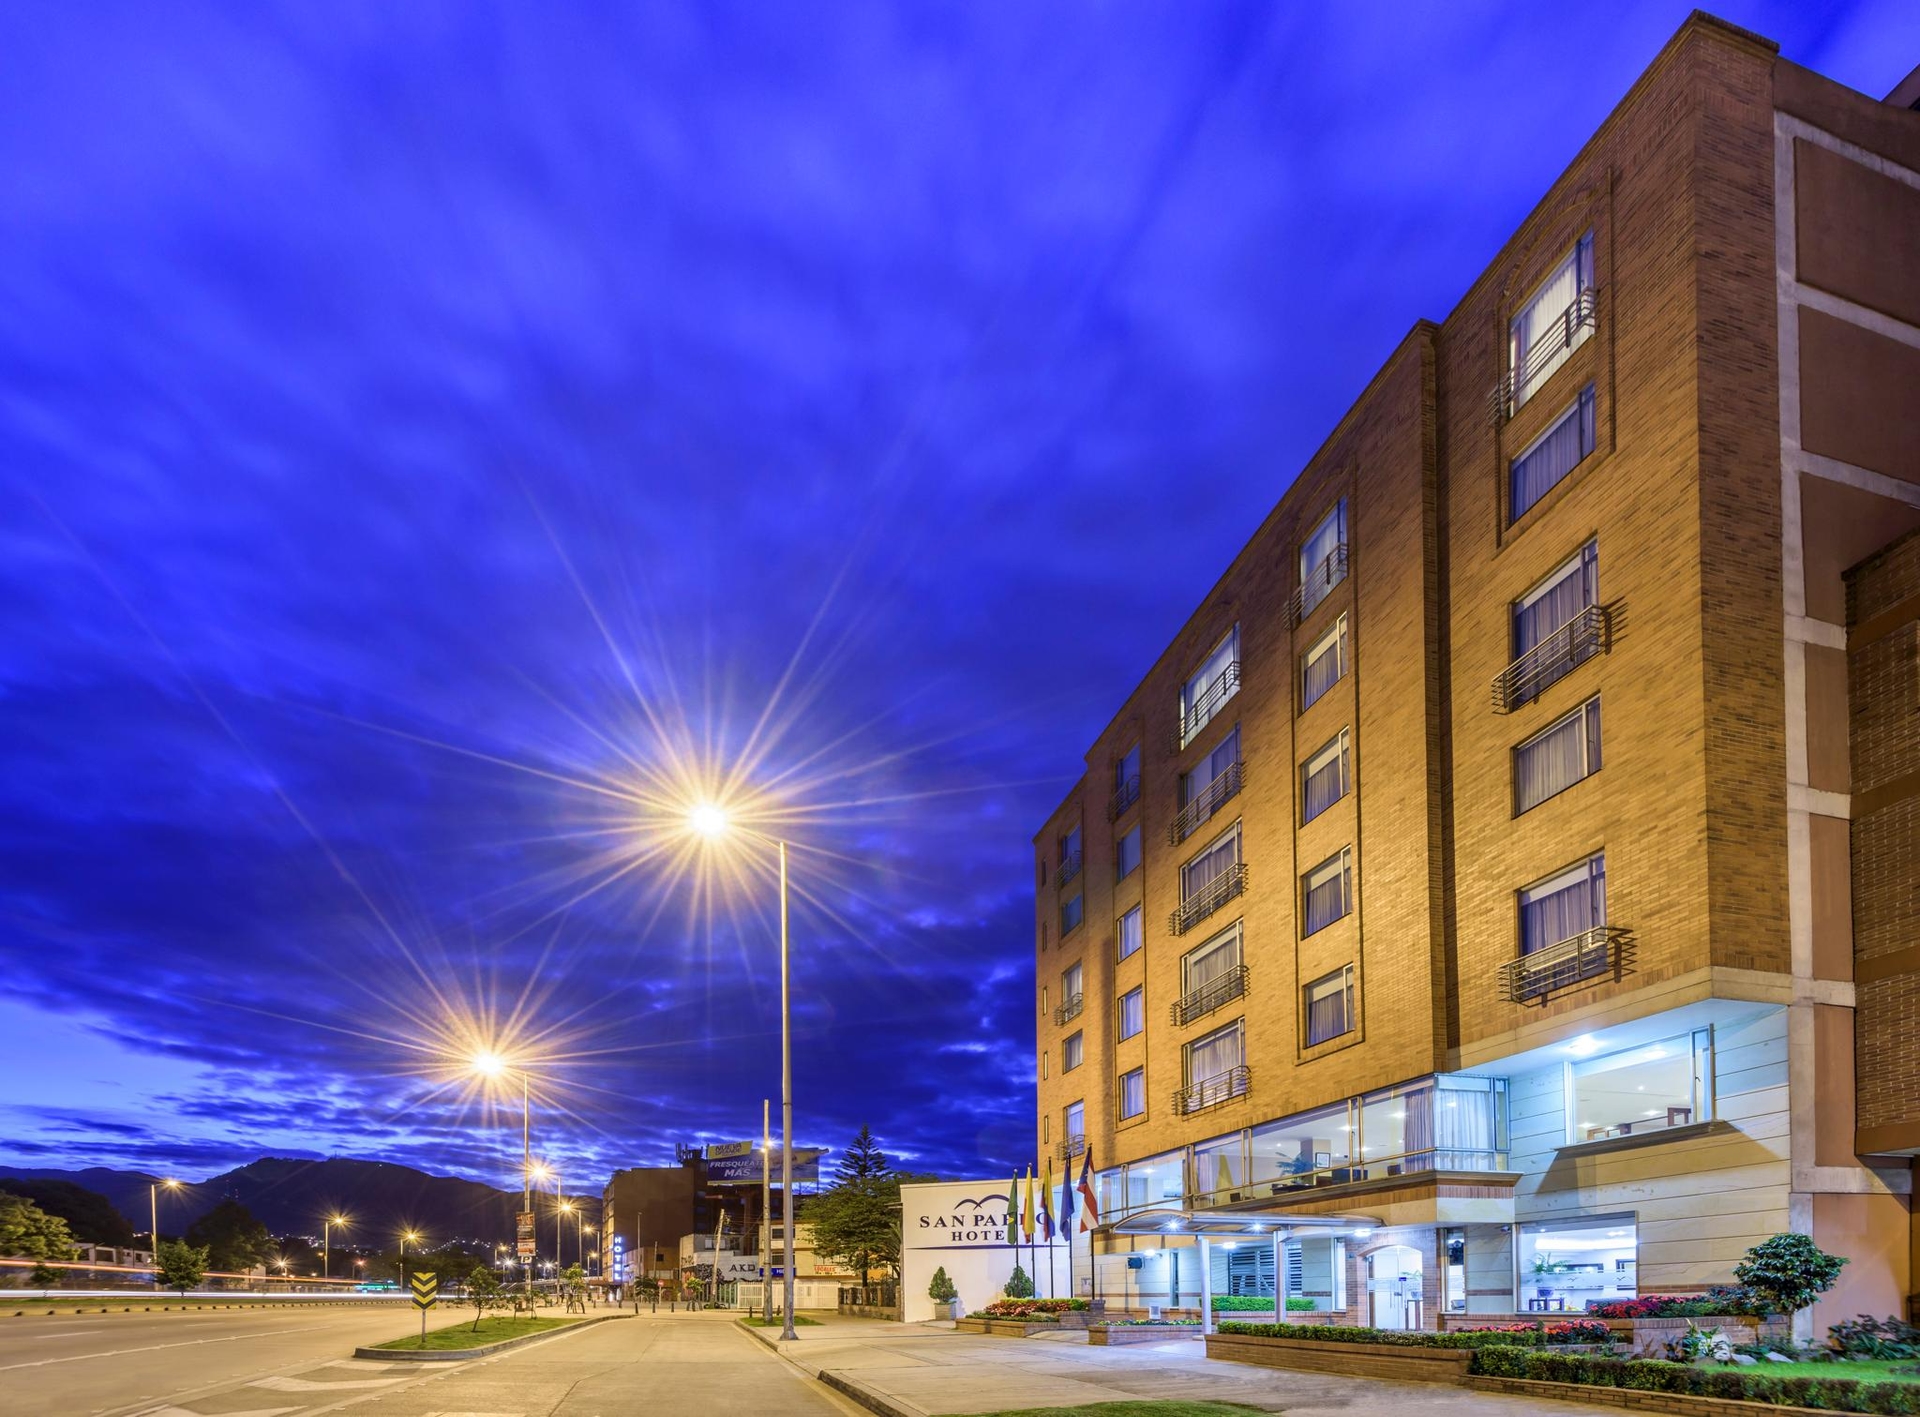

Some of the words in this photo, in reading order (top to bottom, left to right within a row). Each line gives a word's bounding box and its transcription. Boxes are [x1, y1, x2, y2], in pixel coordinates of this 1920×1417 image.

[724, 1167, 751, 1177] MÁS
[920, 1215, 965, 1228] SAN
[952, 1230, 1005, 1241] HOTE
